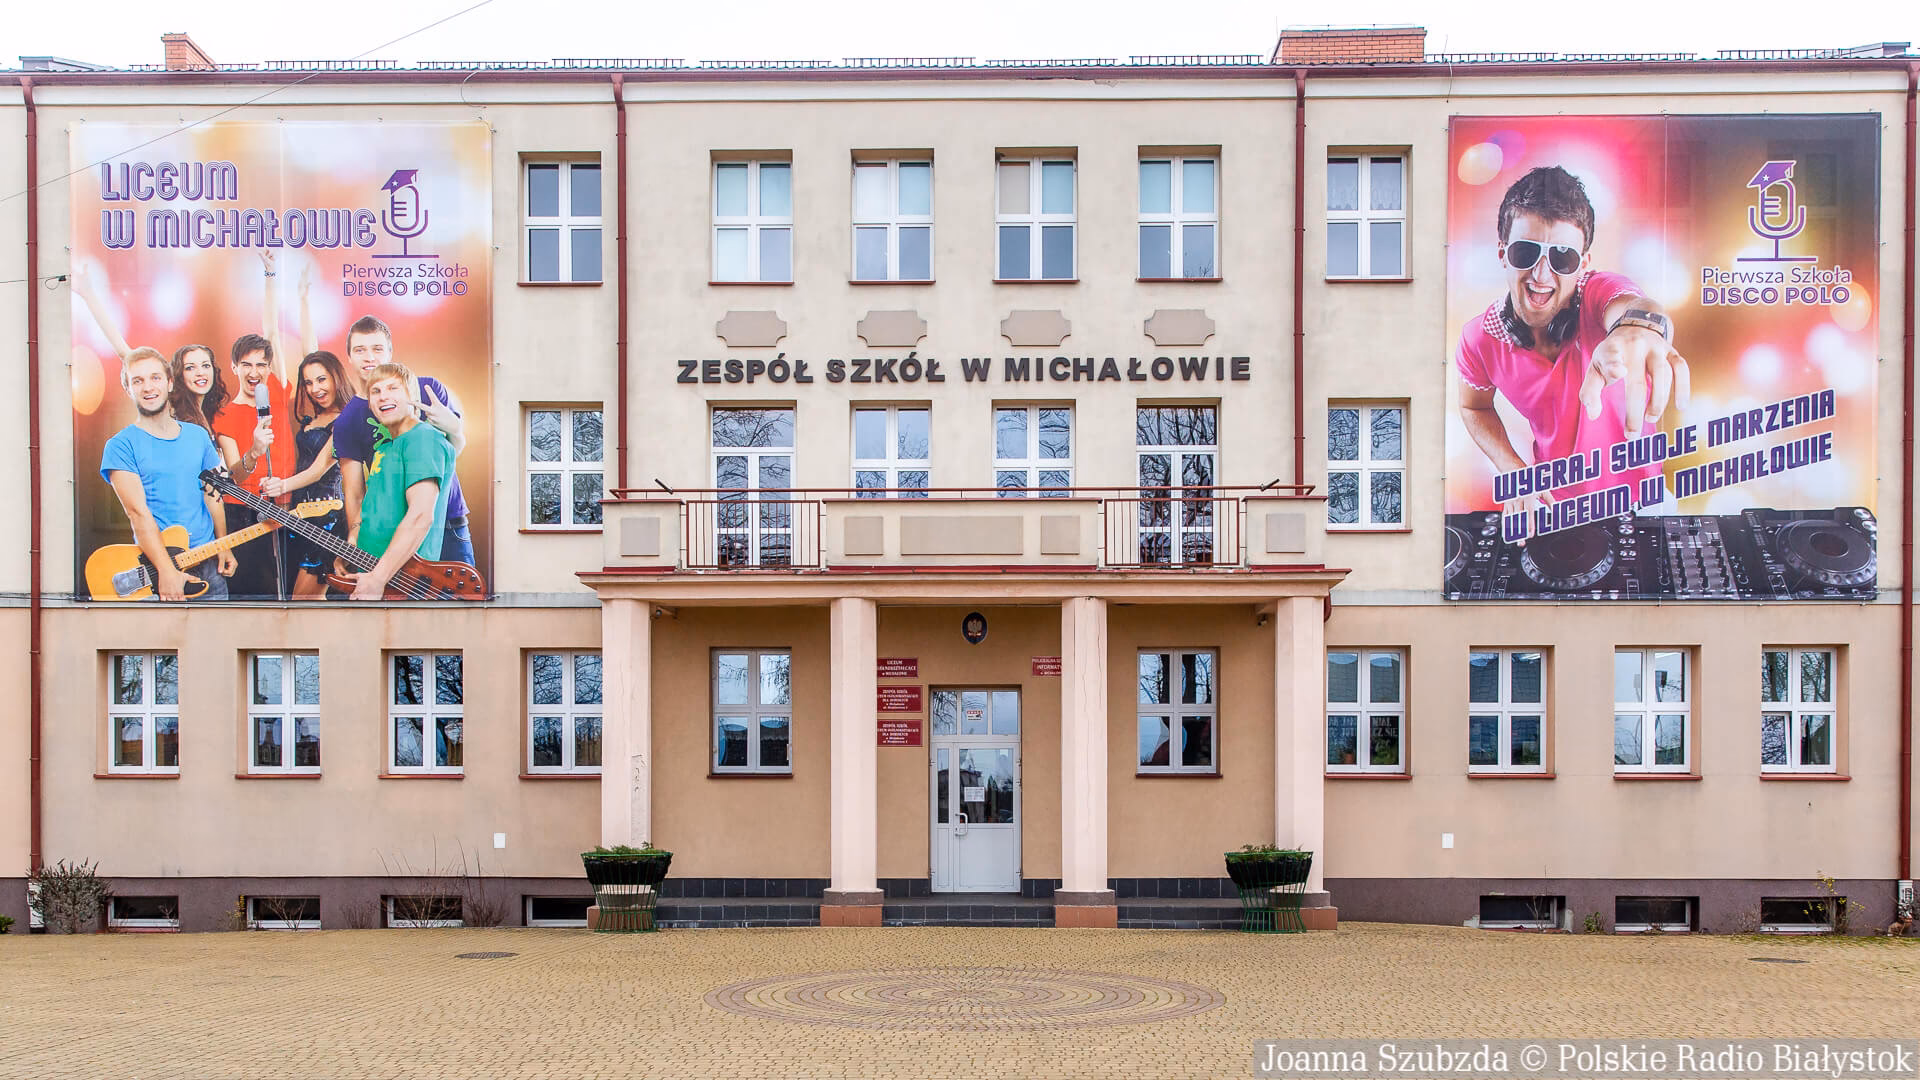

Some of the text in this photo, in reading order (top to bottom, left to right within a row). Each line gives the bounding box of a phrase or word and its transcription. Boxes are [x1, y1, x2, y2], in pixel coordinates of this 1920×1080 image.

[101, 160, 238, 201] LICEUM
[101, 208, 376, 249] W MICHAŁOWIE
[342, 262, 469, 278] Pierwsza Szkoła
[1703, 266, 1850, 283] Pierwsza Szkoła
[343, 281, 468, 297] DISCO POLO
[1702, 287, 1850, 304] DISCO POLO
[677, 353, 1251, 383] ZESPÓŁ SZKÓŁ W MICHAŁOWIE
[1494, 389, 1835, 502] WYGRAJ SWOJE MARZENIA
[1503, 432, 1833, 543] W LICEUM W MICHAŁOWIE
